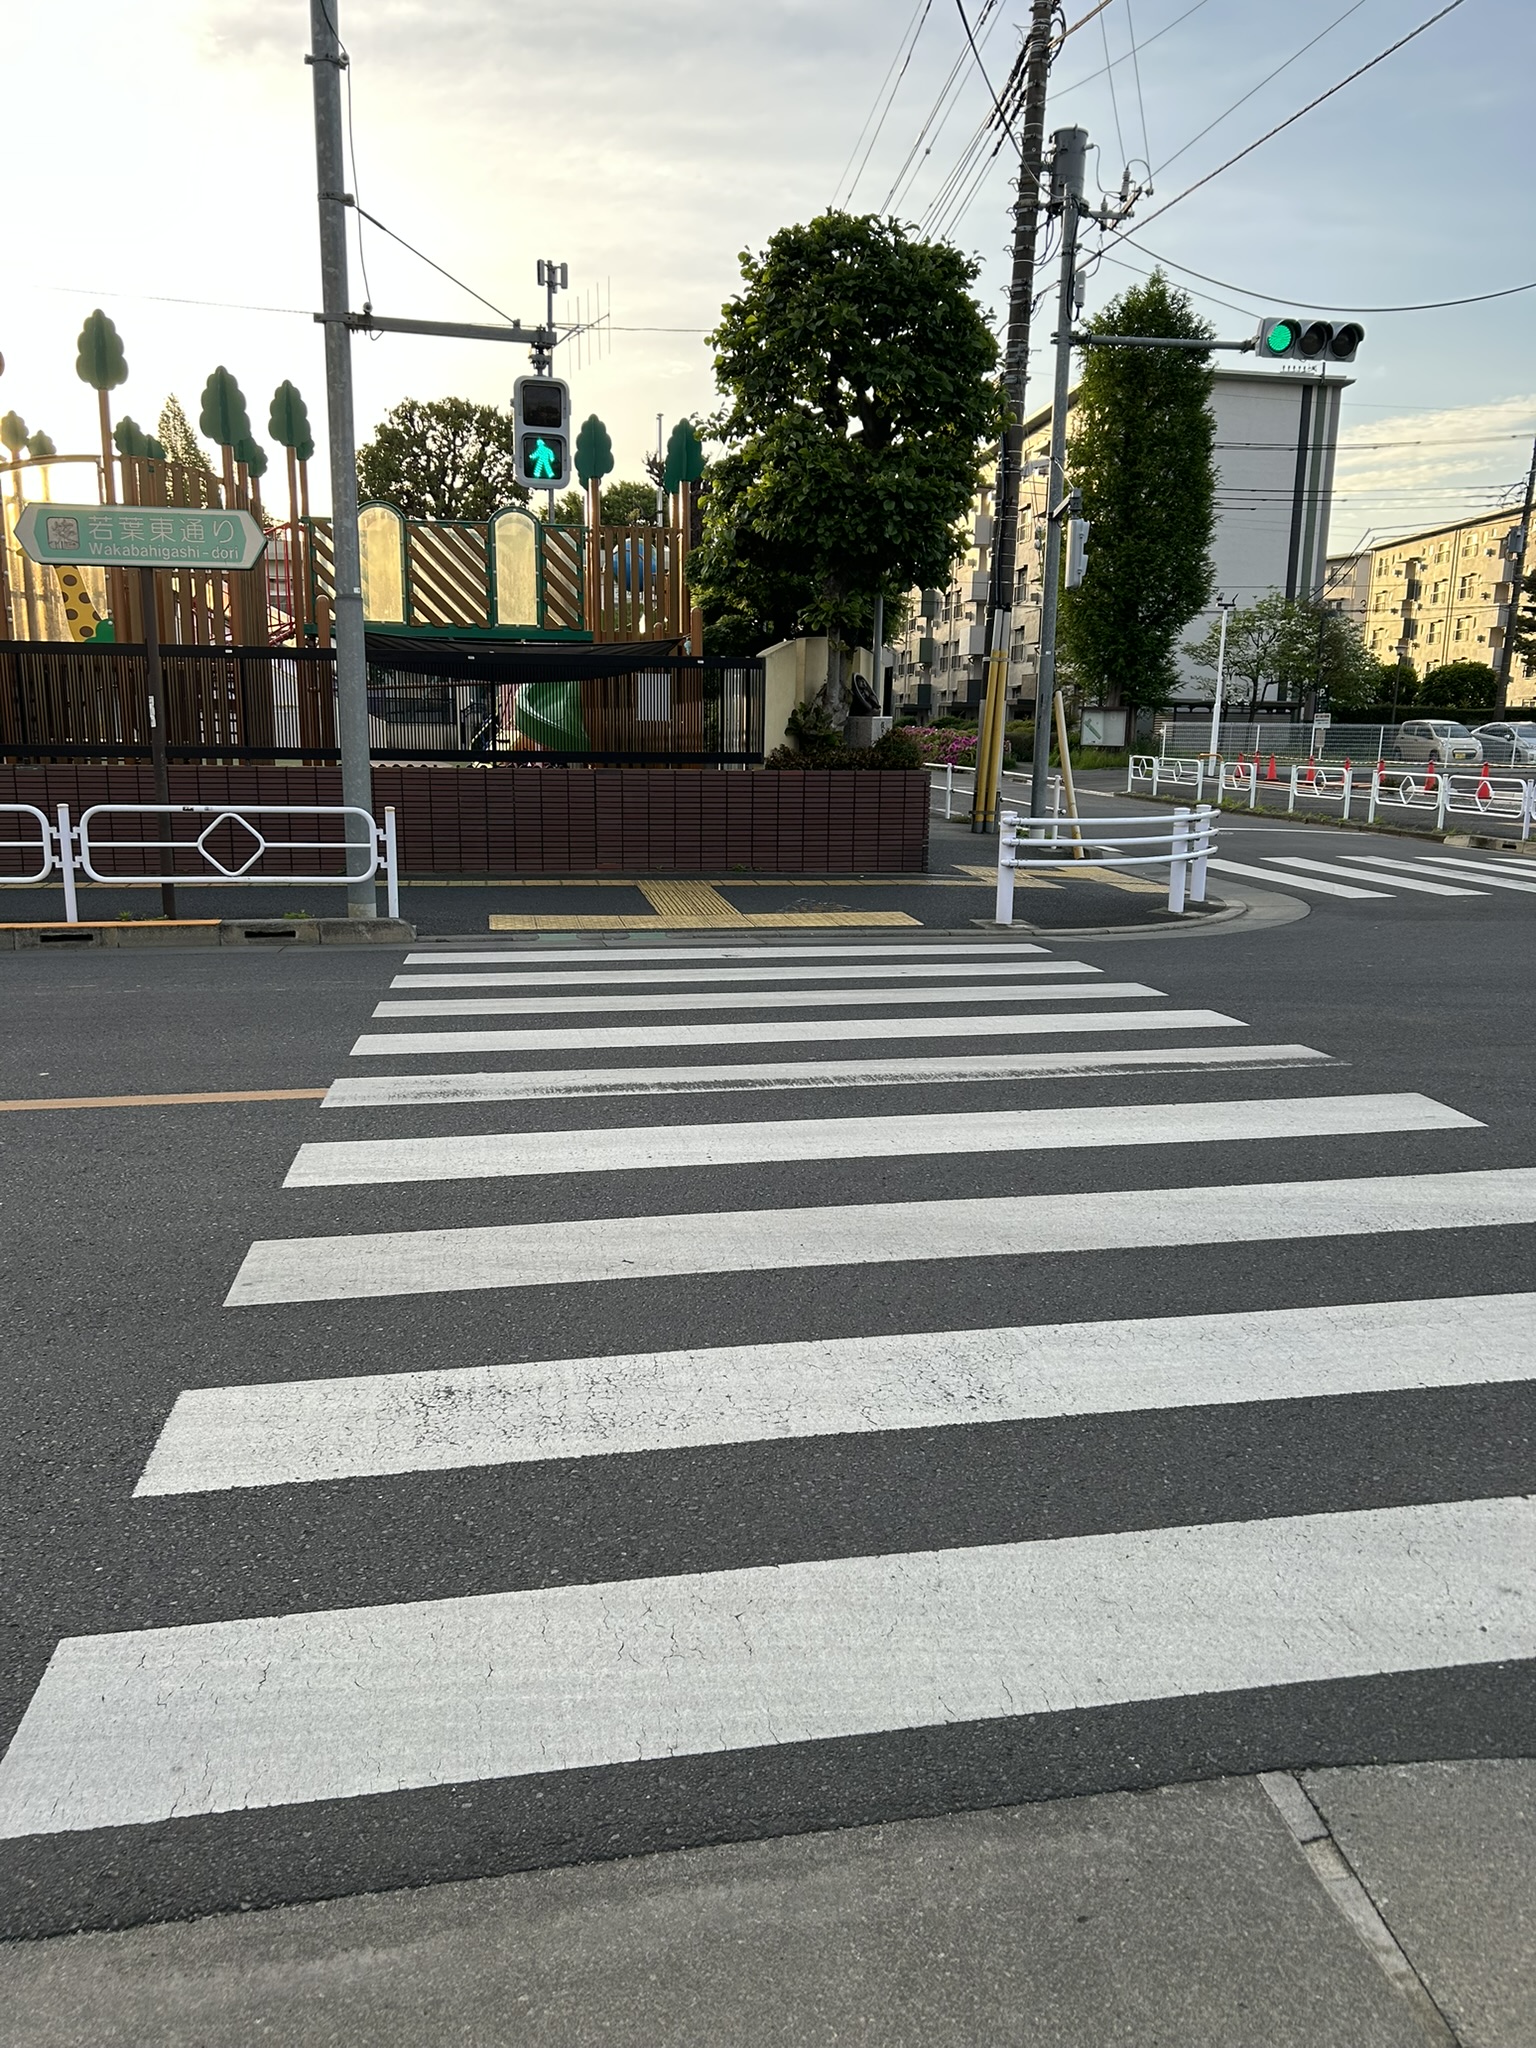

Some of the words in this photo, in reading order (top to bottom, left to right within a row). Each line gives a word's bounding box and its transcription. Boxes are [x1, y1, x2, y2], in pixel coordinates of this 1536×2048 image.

[88, 515, 234, 543] 若葉東通り
[88, 542, 239, 560] Wakabahigashi-dori
